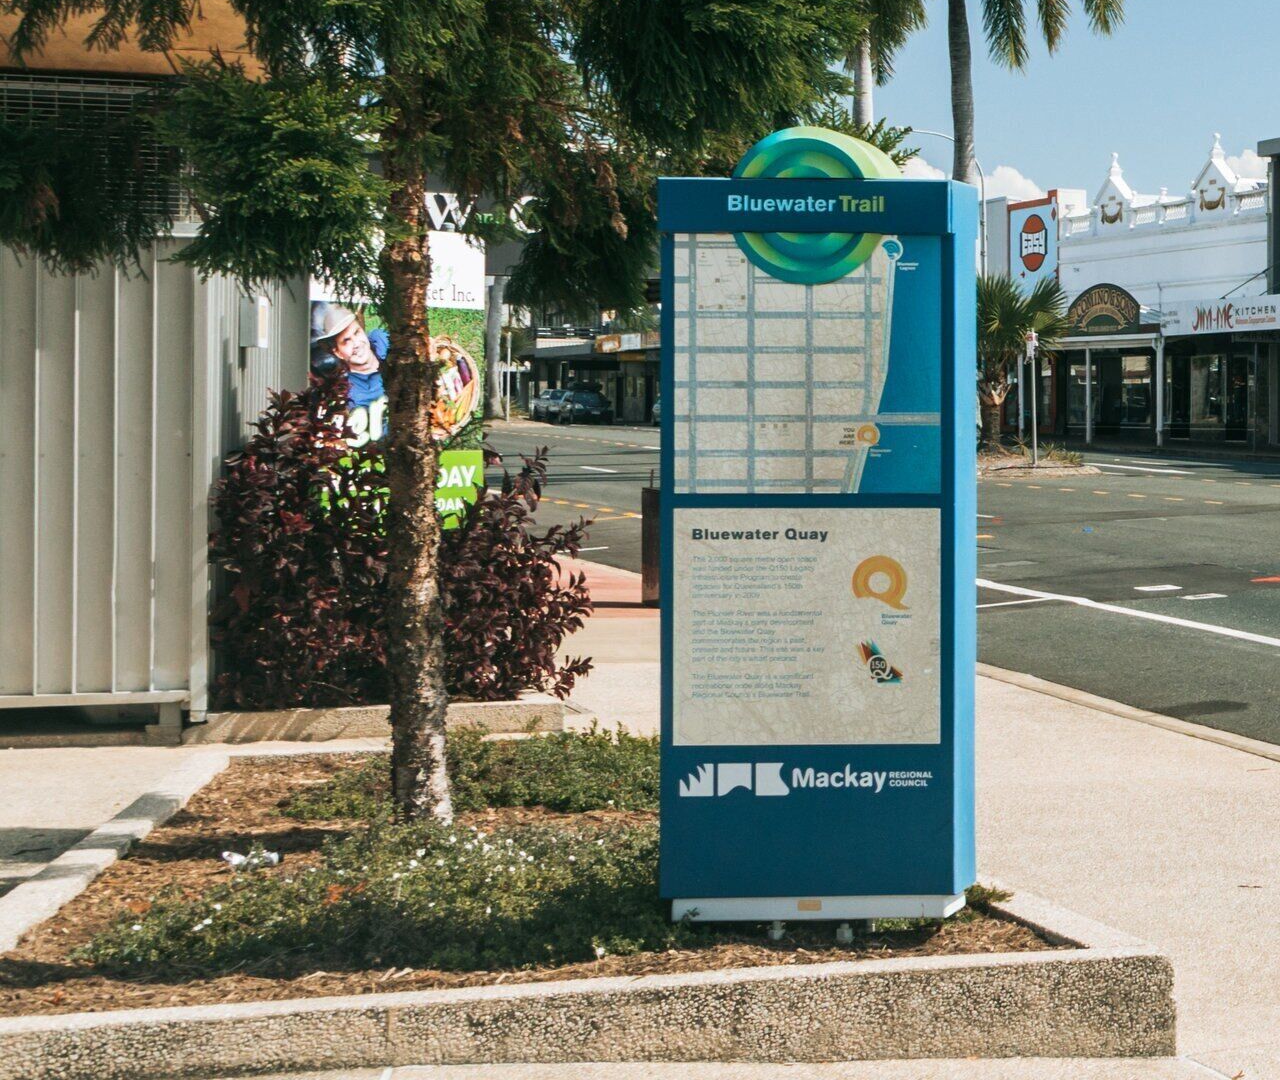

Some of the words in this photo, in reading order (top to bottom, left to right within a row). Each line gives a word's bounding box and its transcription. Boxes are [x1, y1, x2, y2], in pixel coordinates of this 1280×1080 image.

[727, 194, 836, 212] Bluewater
[838, 195, 885, 212] Trail
[452, 284, 475, 302] Inc.
[1235, 305, 1276, 316] KITCHEN
[692, 528, 779, 540] Bluewater
[784, 528, 828, 543] Quay
[792, 763, 887, 793] Mackay
